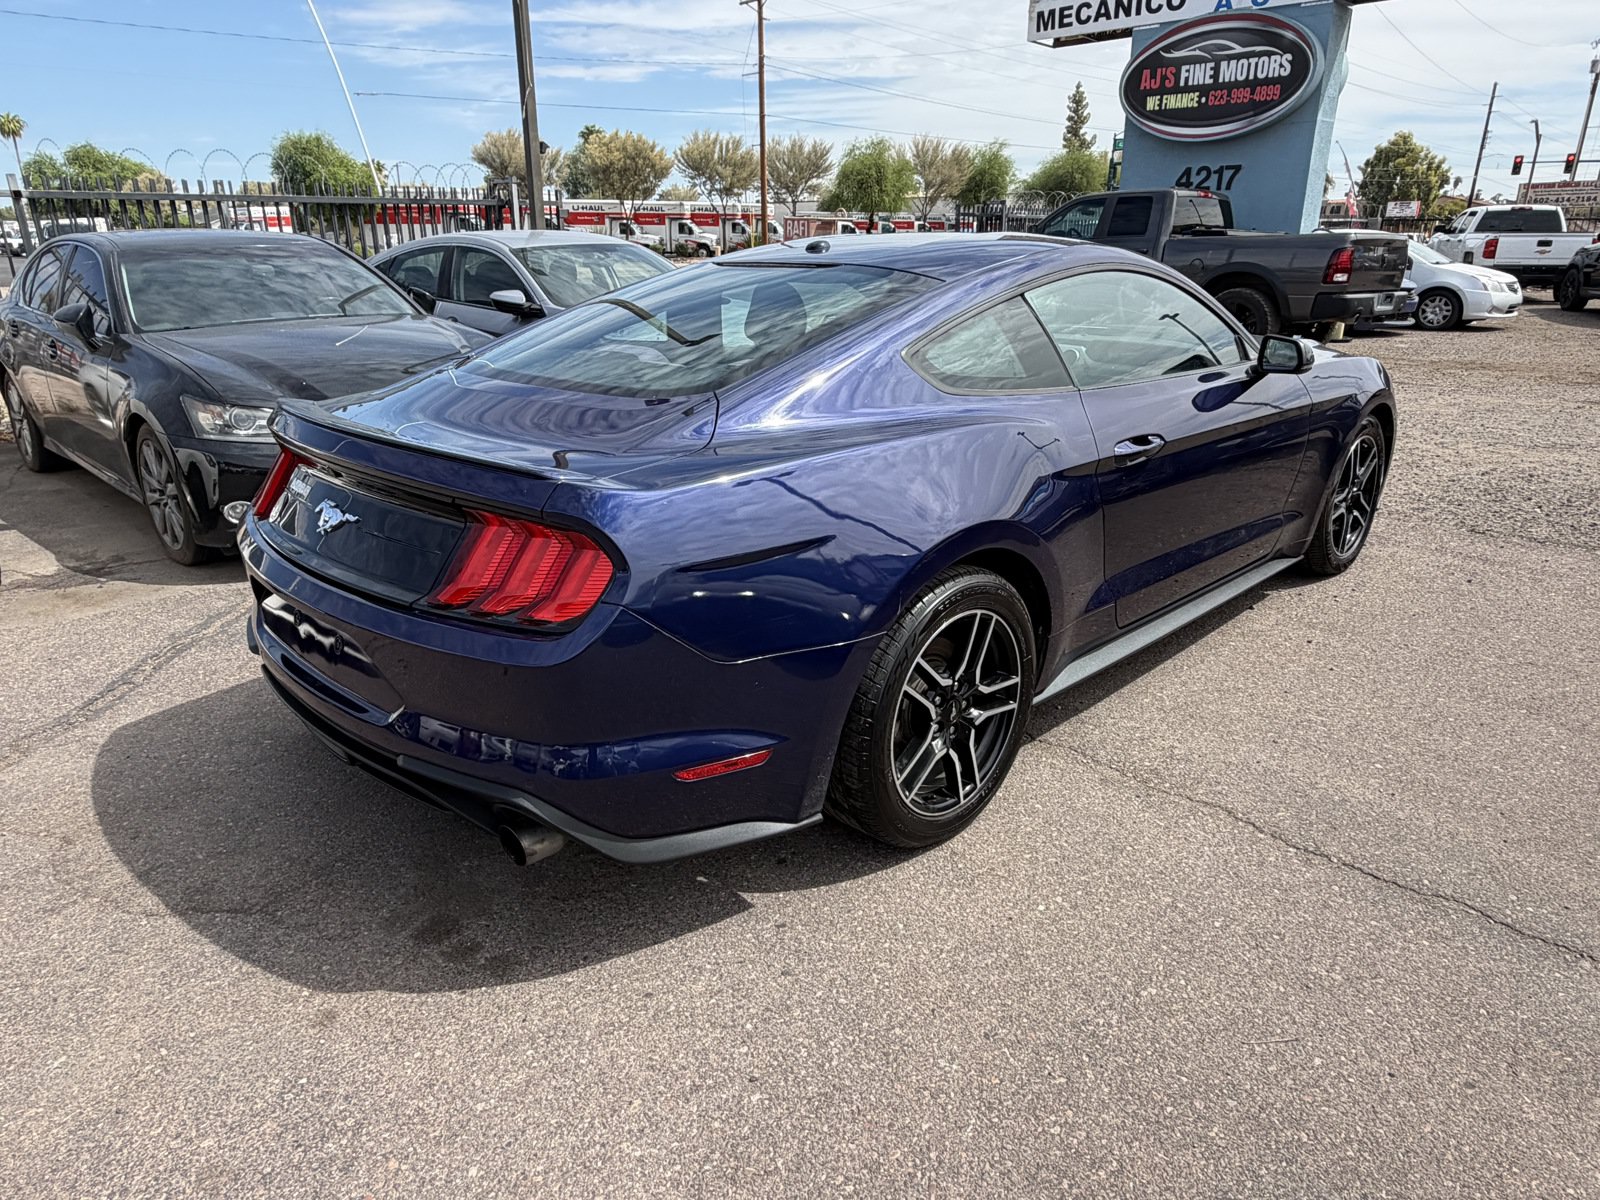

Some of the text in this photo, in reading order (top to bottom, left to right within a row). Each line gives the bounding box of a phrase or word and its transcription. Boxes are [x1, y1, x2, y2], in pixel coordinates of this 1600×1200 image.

[1139, 53, 1293, 90] AJ'S FINE MOTORS
[1146, 84, 1282, 111] WE FINANCE 623-999-4899
[1174, 164, 1242, 191] 4217
[1533, 196, 1598, 204] 602-434-7184
